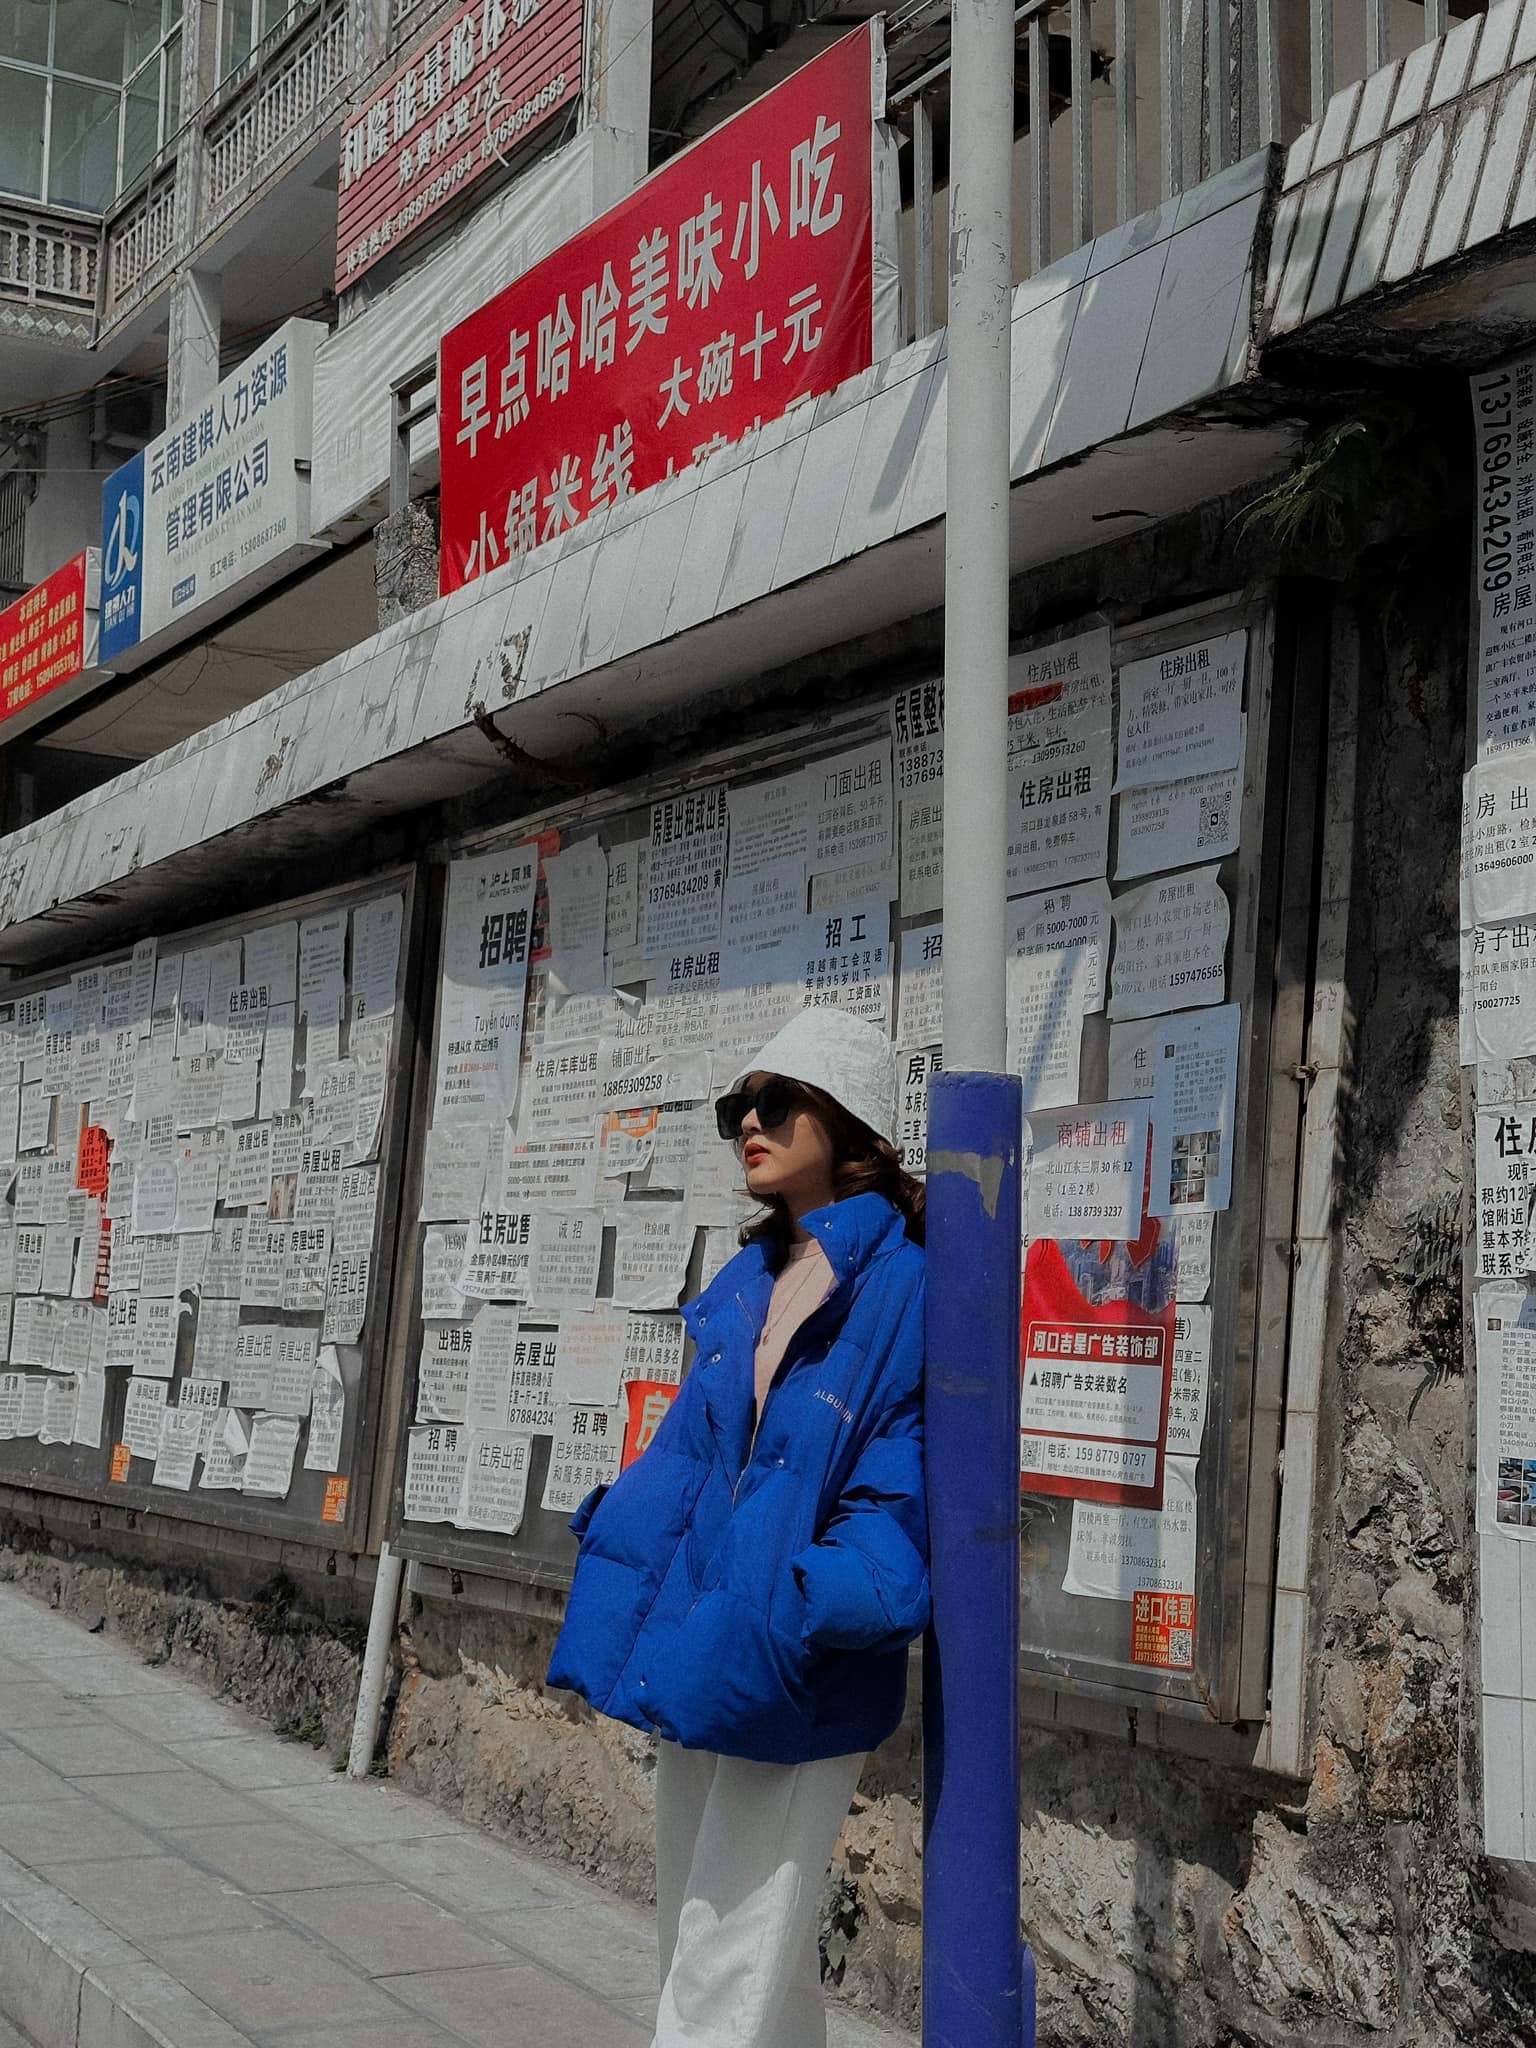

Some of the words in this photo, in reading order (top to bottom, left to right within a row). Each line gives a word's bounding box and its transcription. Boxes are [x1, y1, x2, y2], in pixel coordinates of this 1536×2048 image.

[398, 66, 502, 188] 免费体验7次
[456, 115, 843, 459] 早点哈哈美味小吃
[657, 284, 823, 430] 大碗十元
[151, 343, 287, 495] 云南建祺人力资源
[1479, 372, 1513, 593] 13769434209
[166, 438, 269, 556] 管理有限公司
[464, 419, 636, 581] 小锅米线
[1028, 651, 1081, 683] 住房出租
[1160, 649, 1210, 681] 住房出租
[824, 759, 882, 801] 门面出租
[1019, 766, 1092, 810] 住房出租
[652, 785, 727, 847] 房屋出租或出售
[1474, 853, 1534, 874] 13649606000
[649, 874, 709, 905] 13769434209
[1159, 882, 1195, 904] 房屋出租
[1043, 894, 1071, 915] 招聘
[825, 914, 866, 949] 招工
[1046, 915, 1088, 936] 5000-7000
[1089, 911, 1100, 926] 元
[479, 908, 528, 969] 招聘
[922, 934, 943, 961] 招
[671, 951, 720, 981] 住房出租
[806, 947, 883, 976] 招越南工会汉语
[1087, 952, 1098, 968] 元
[1087, 973, 1097, 989] 元
[229, 985, 268, 1013] 住房出租
[536, 1052, 598, 1079] 住房/车库出租
[1134, 1048, 1146, 1069] 住
[321, 1071, 356, 1098] 住房出租
[603, 1073, 663, 1098] 18869309258
[238, 1128, 269, 1152] 房屋出租
[1056, 1120, 1127, 1149] 商铺出租
[1494, 1116, 1536, 1158] 住
[303, 1149, 341, 1174] 房屋出租
[1068, 1206, 1082, 1218] 138
[1083, 1206, 1102, 1218] 8739
[1103, 1206, 1123, 1218] 3237
[1482, 1208, 1524, 1228] 馆附近
[291, 1228, 325, 1252] 房屋出租
[480, 1211, 531, 1245] 住房出售
[330, 1256, 369, 1298] 房屋出售
[237, 1334, 272, 1358] 房屋出租
[278, 1340, 312, 1362] 房屋出租
[438, 1328, 473, 1353] 出租房
[515, 1340, 556, 1367] 房屋出
[1033, 1330, 1159, 1359] 河口吉星广告装饰部
[1041, 1371, 1127, 1395] 招聘广告安装数名
[573, 1411, 608, 1437] 招聘
[428, 1428, 457, 1452] 招聘
[480, 1441, 524, 1471] 住房出租
[1047, 1443, 1071, 1460] 电话：
[1076, 1446, 1094, 1462] 159
[1095, 1449, 1120, 1465] 8779
[1121, 1452, 1147, 1468] 0797
[1121, 1555, 1166, 1570] 13708632314
[1137, 1576, 1183, 1591] 13708632314
[1135, 1594, 1192, 1627] 进口伟哥
